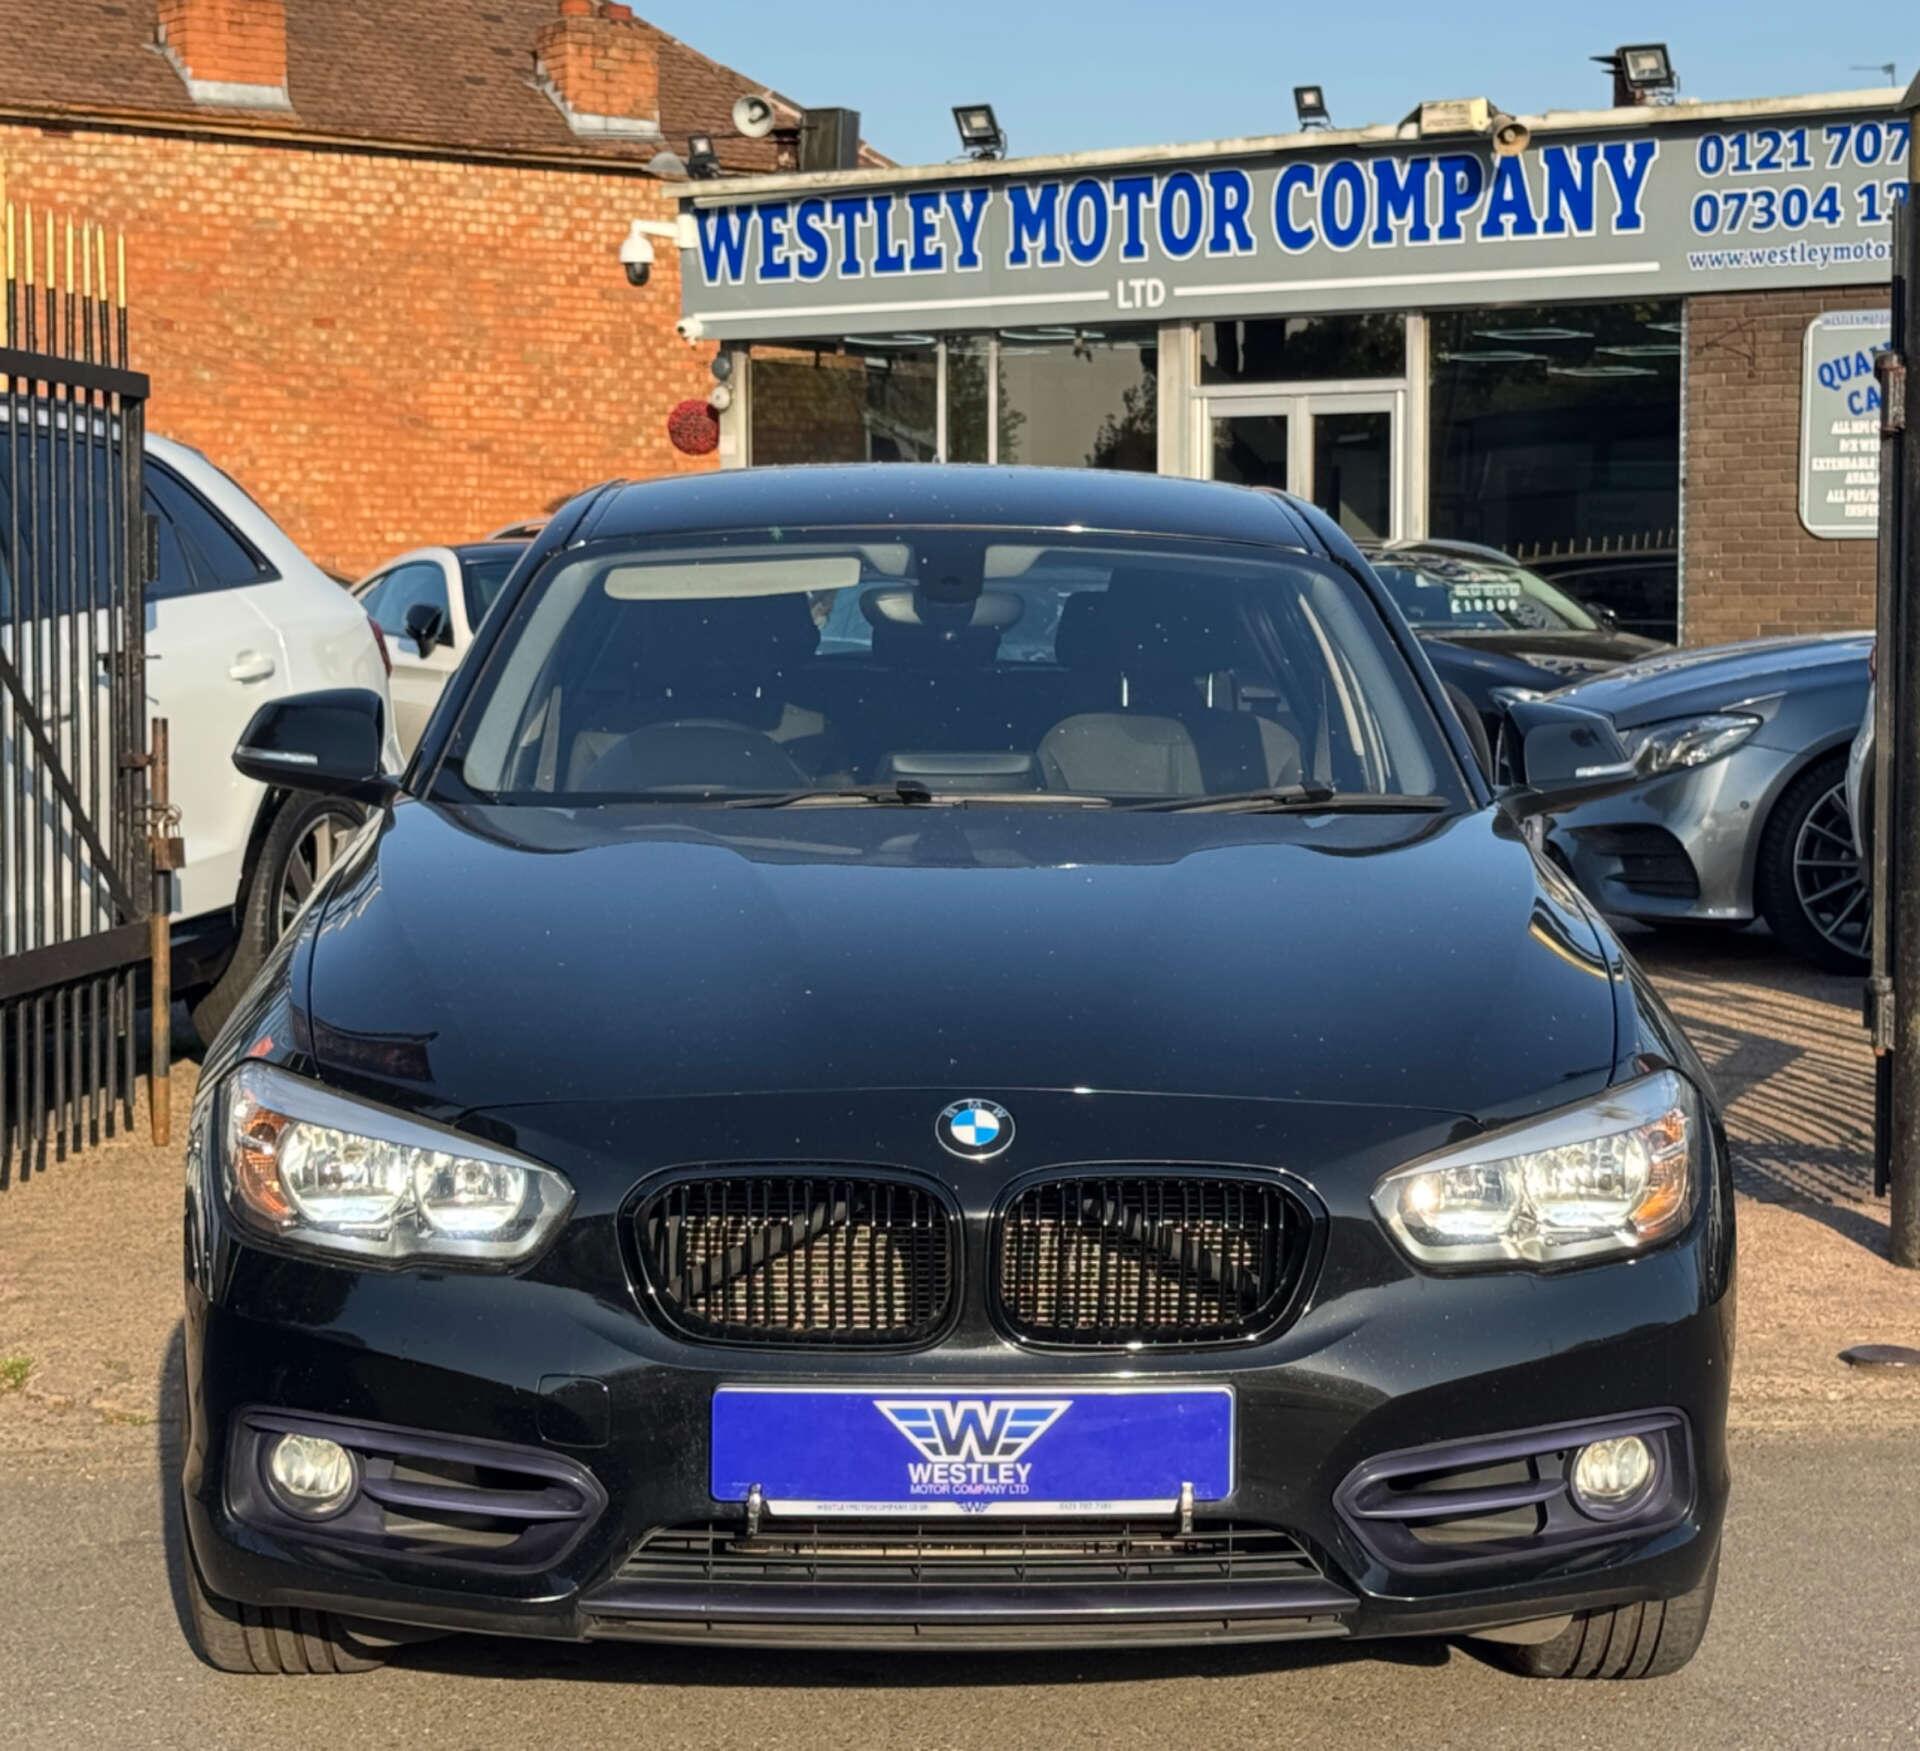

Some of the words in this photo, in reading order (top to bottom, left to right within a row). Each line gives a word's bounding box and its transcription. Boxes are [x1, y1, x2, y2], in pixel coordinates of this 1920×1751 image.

[1697, 129, 1814, 177] 0121
[1824, 119, 1910, 167] 707
[699, 188, 993, 286] WESTLEY
[1005, 168, 1256, 269] MOTOR
[1272, 139, 1659, 254] COMPANY
[1692, 184, 1842, 237] 07304
[1688, 240, 1893, 268] www.westleymoto
[1117, 280, 1165, 308] LTD
[907, 1463, 1032, 1484] WESTLEY
[910, 1484, 950, 1495] MOTOR
[952, 1484, 1007, 1495] COMPANY
[1009, 1484, 1030, 1495] LTD
